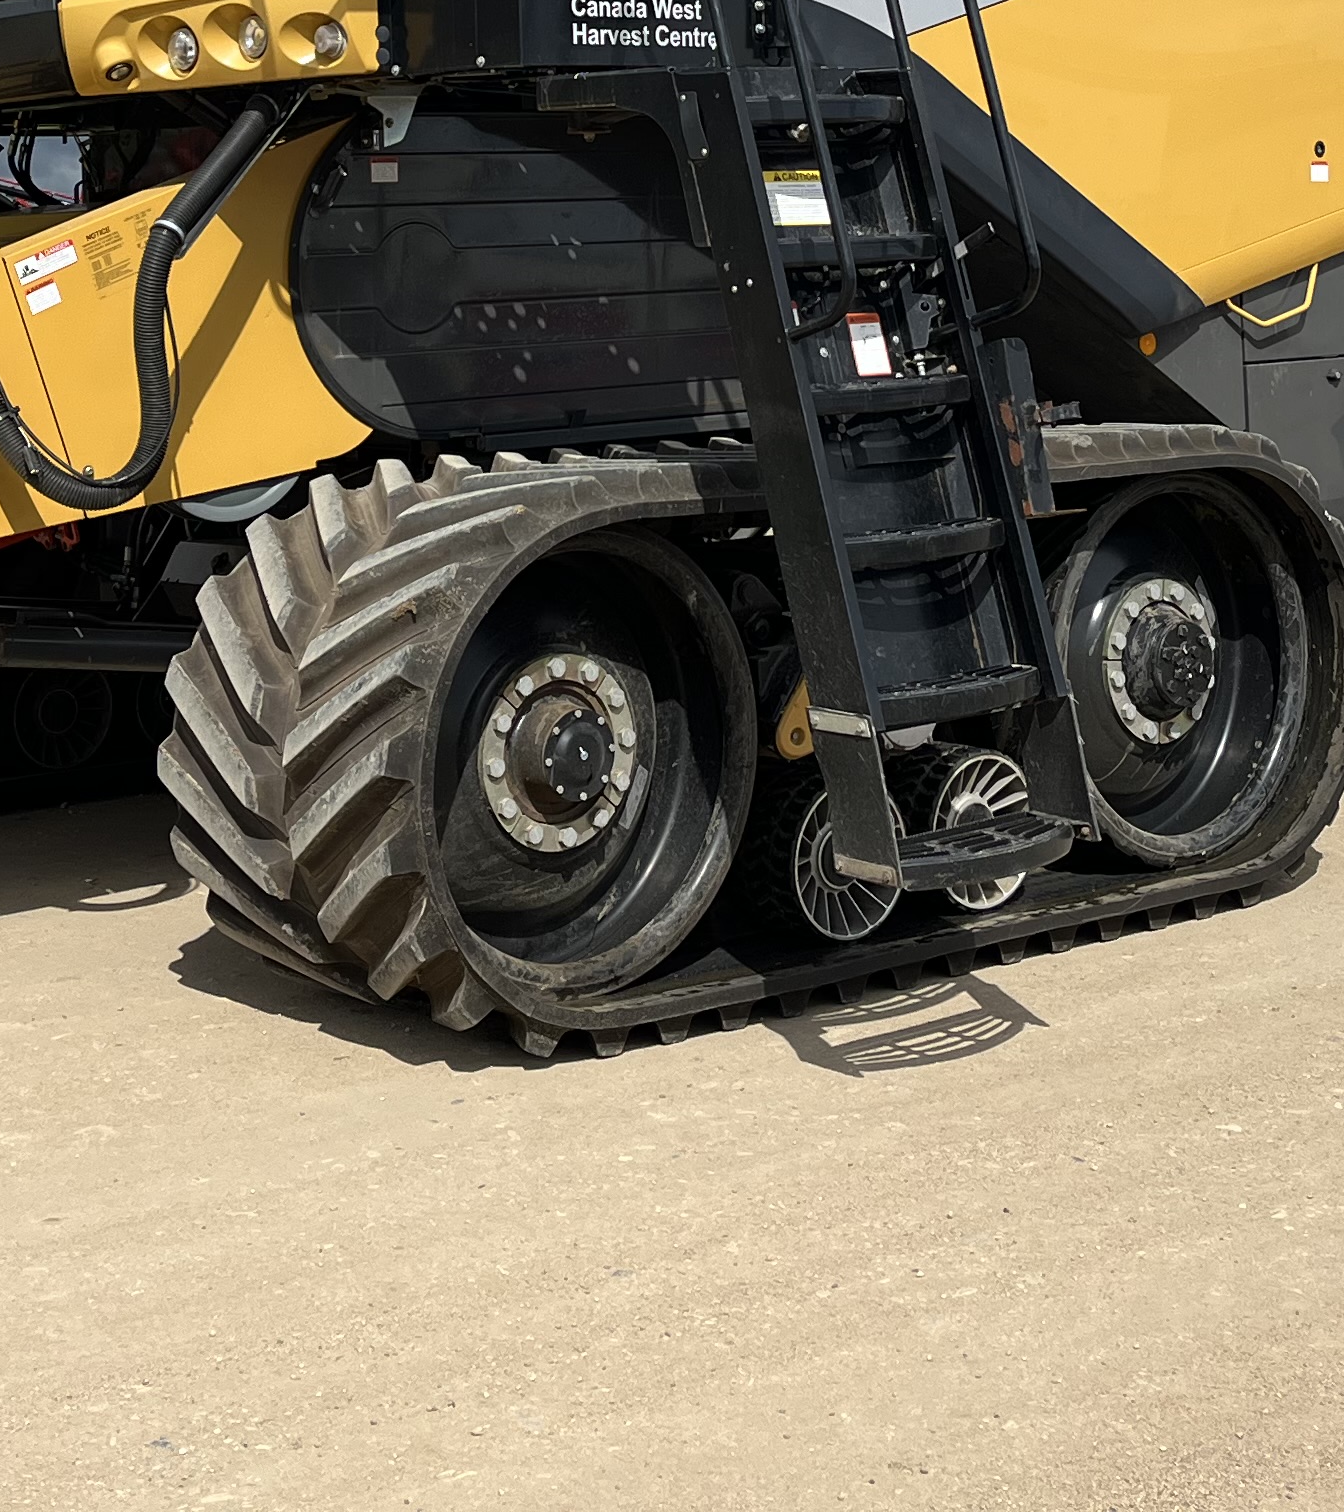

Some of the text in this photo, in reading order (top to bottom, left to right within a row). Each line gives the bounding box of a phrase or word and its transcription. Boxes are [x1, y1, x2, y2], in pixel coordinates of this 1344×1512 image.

[572, 23, 717, 50] Harvest Centre
[44, 239, 71, 256] DANGER
